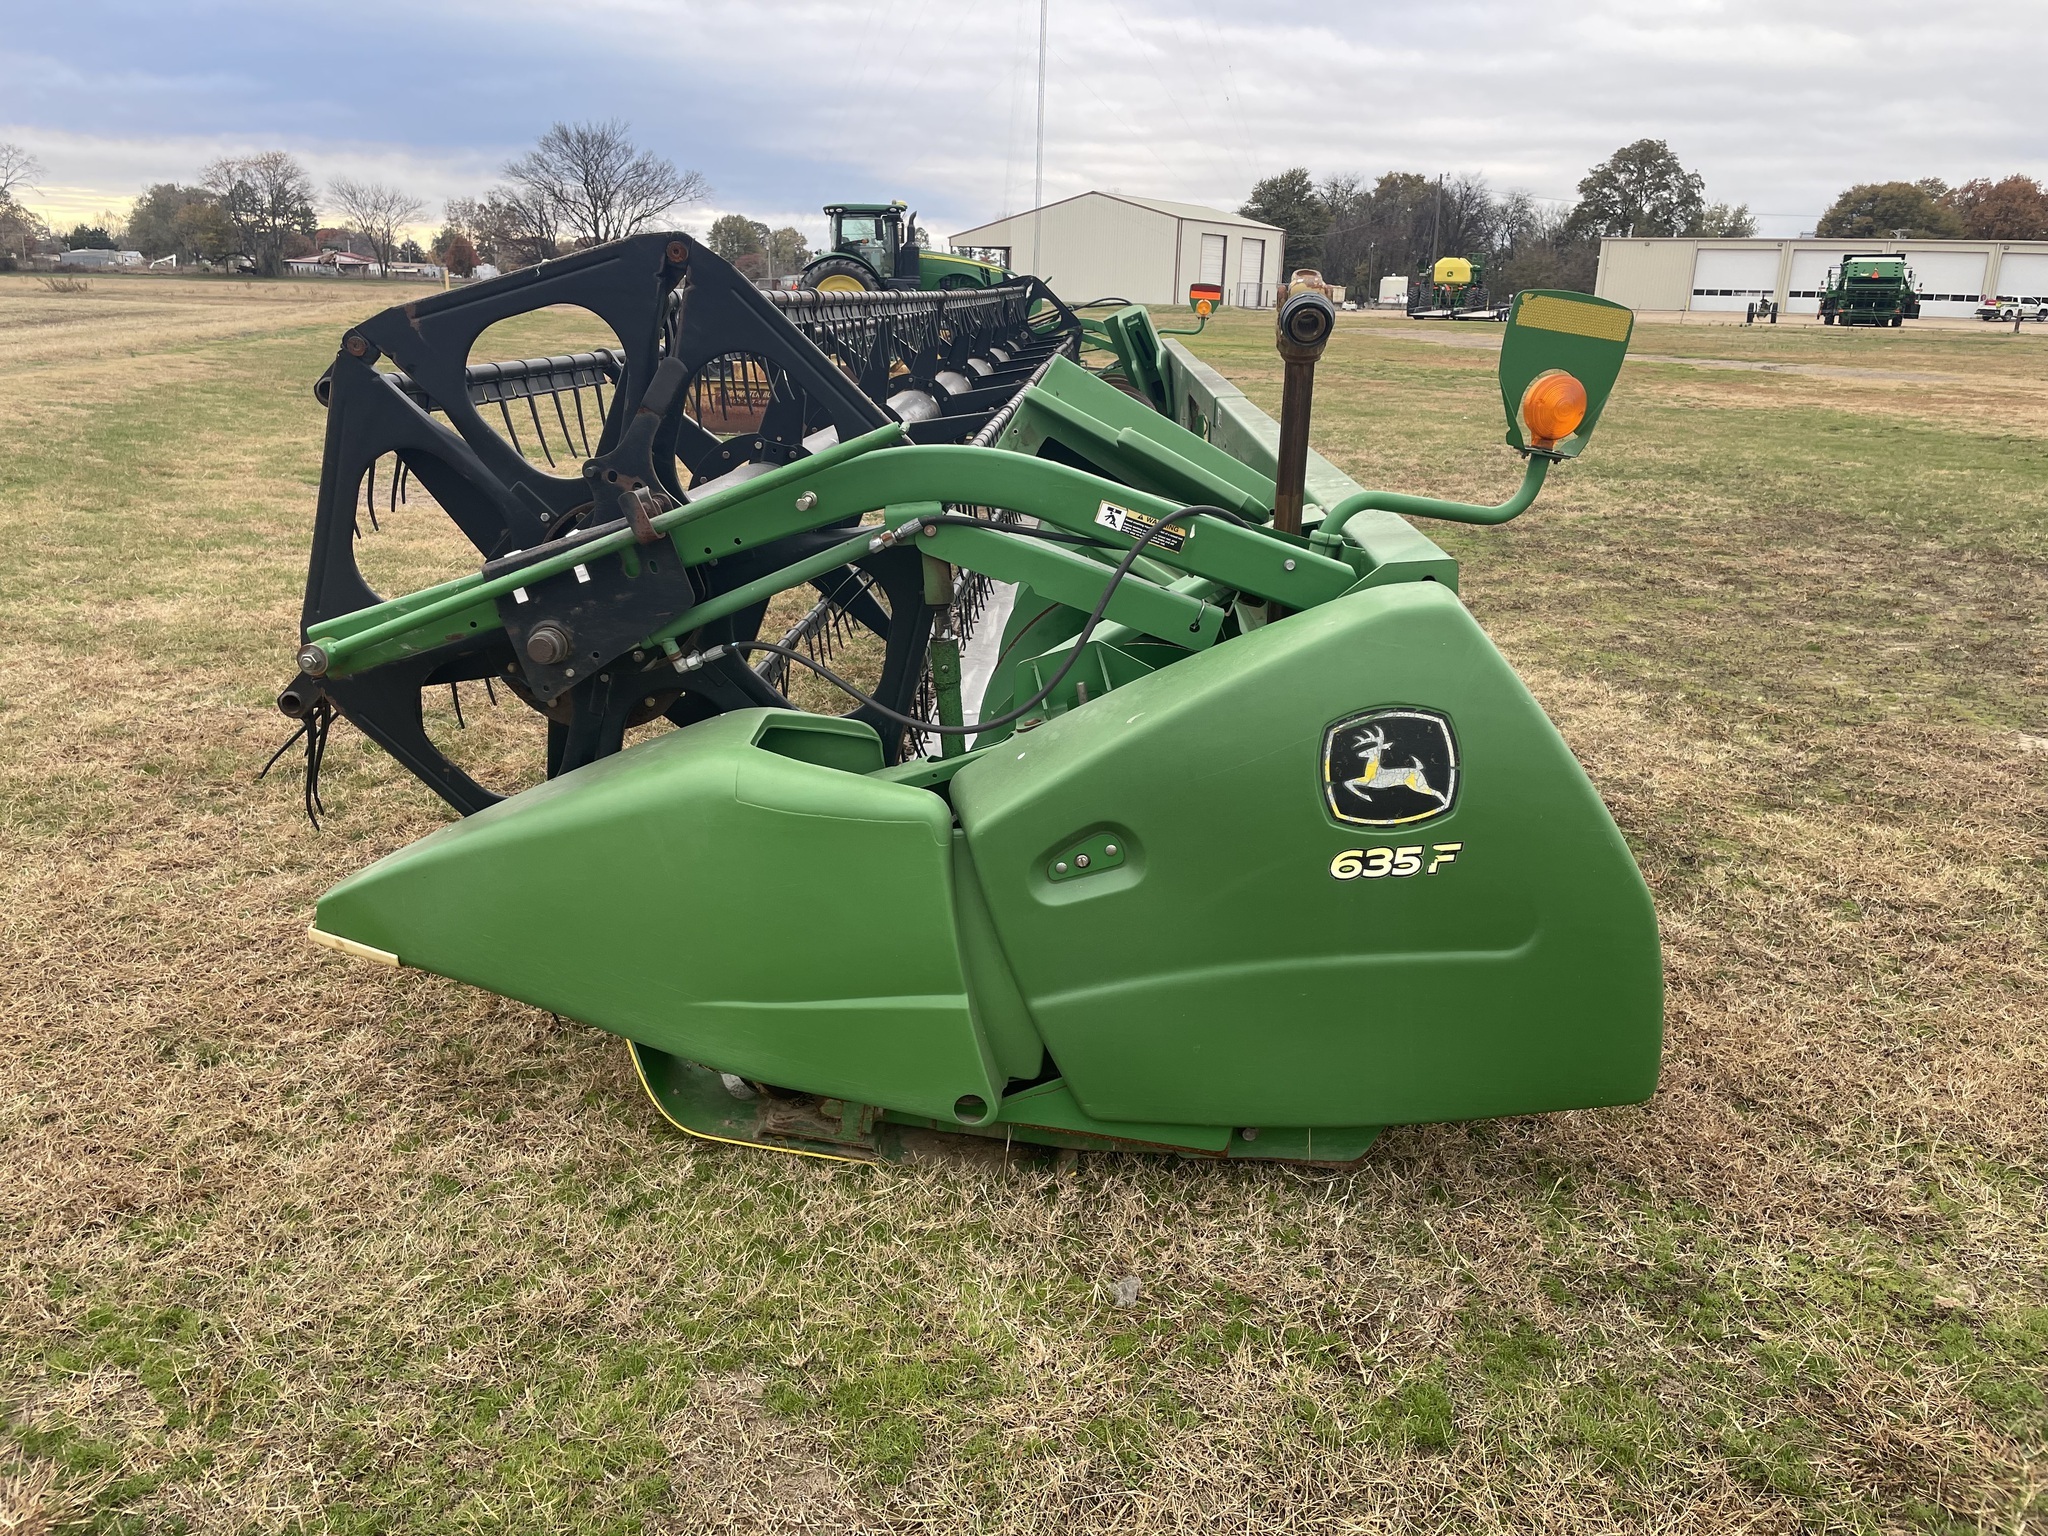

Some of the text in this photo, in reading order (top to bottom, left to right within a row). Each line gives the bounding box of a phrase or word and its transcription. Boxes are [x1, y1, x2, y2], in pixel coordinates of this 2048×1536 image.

[1146, 516, 1180, 533] WANING
[1330, 841, 1464, 880] 635 F
